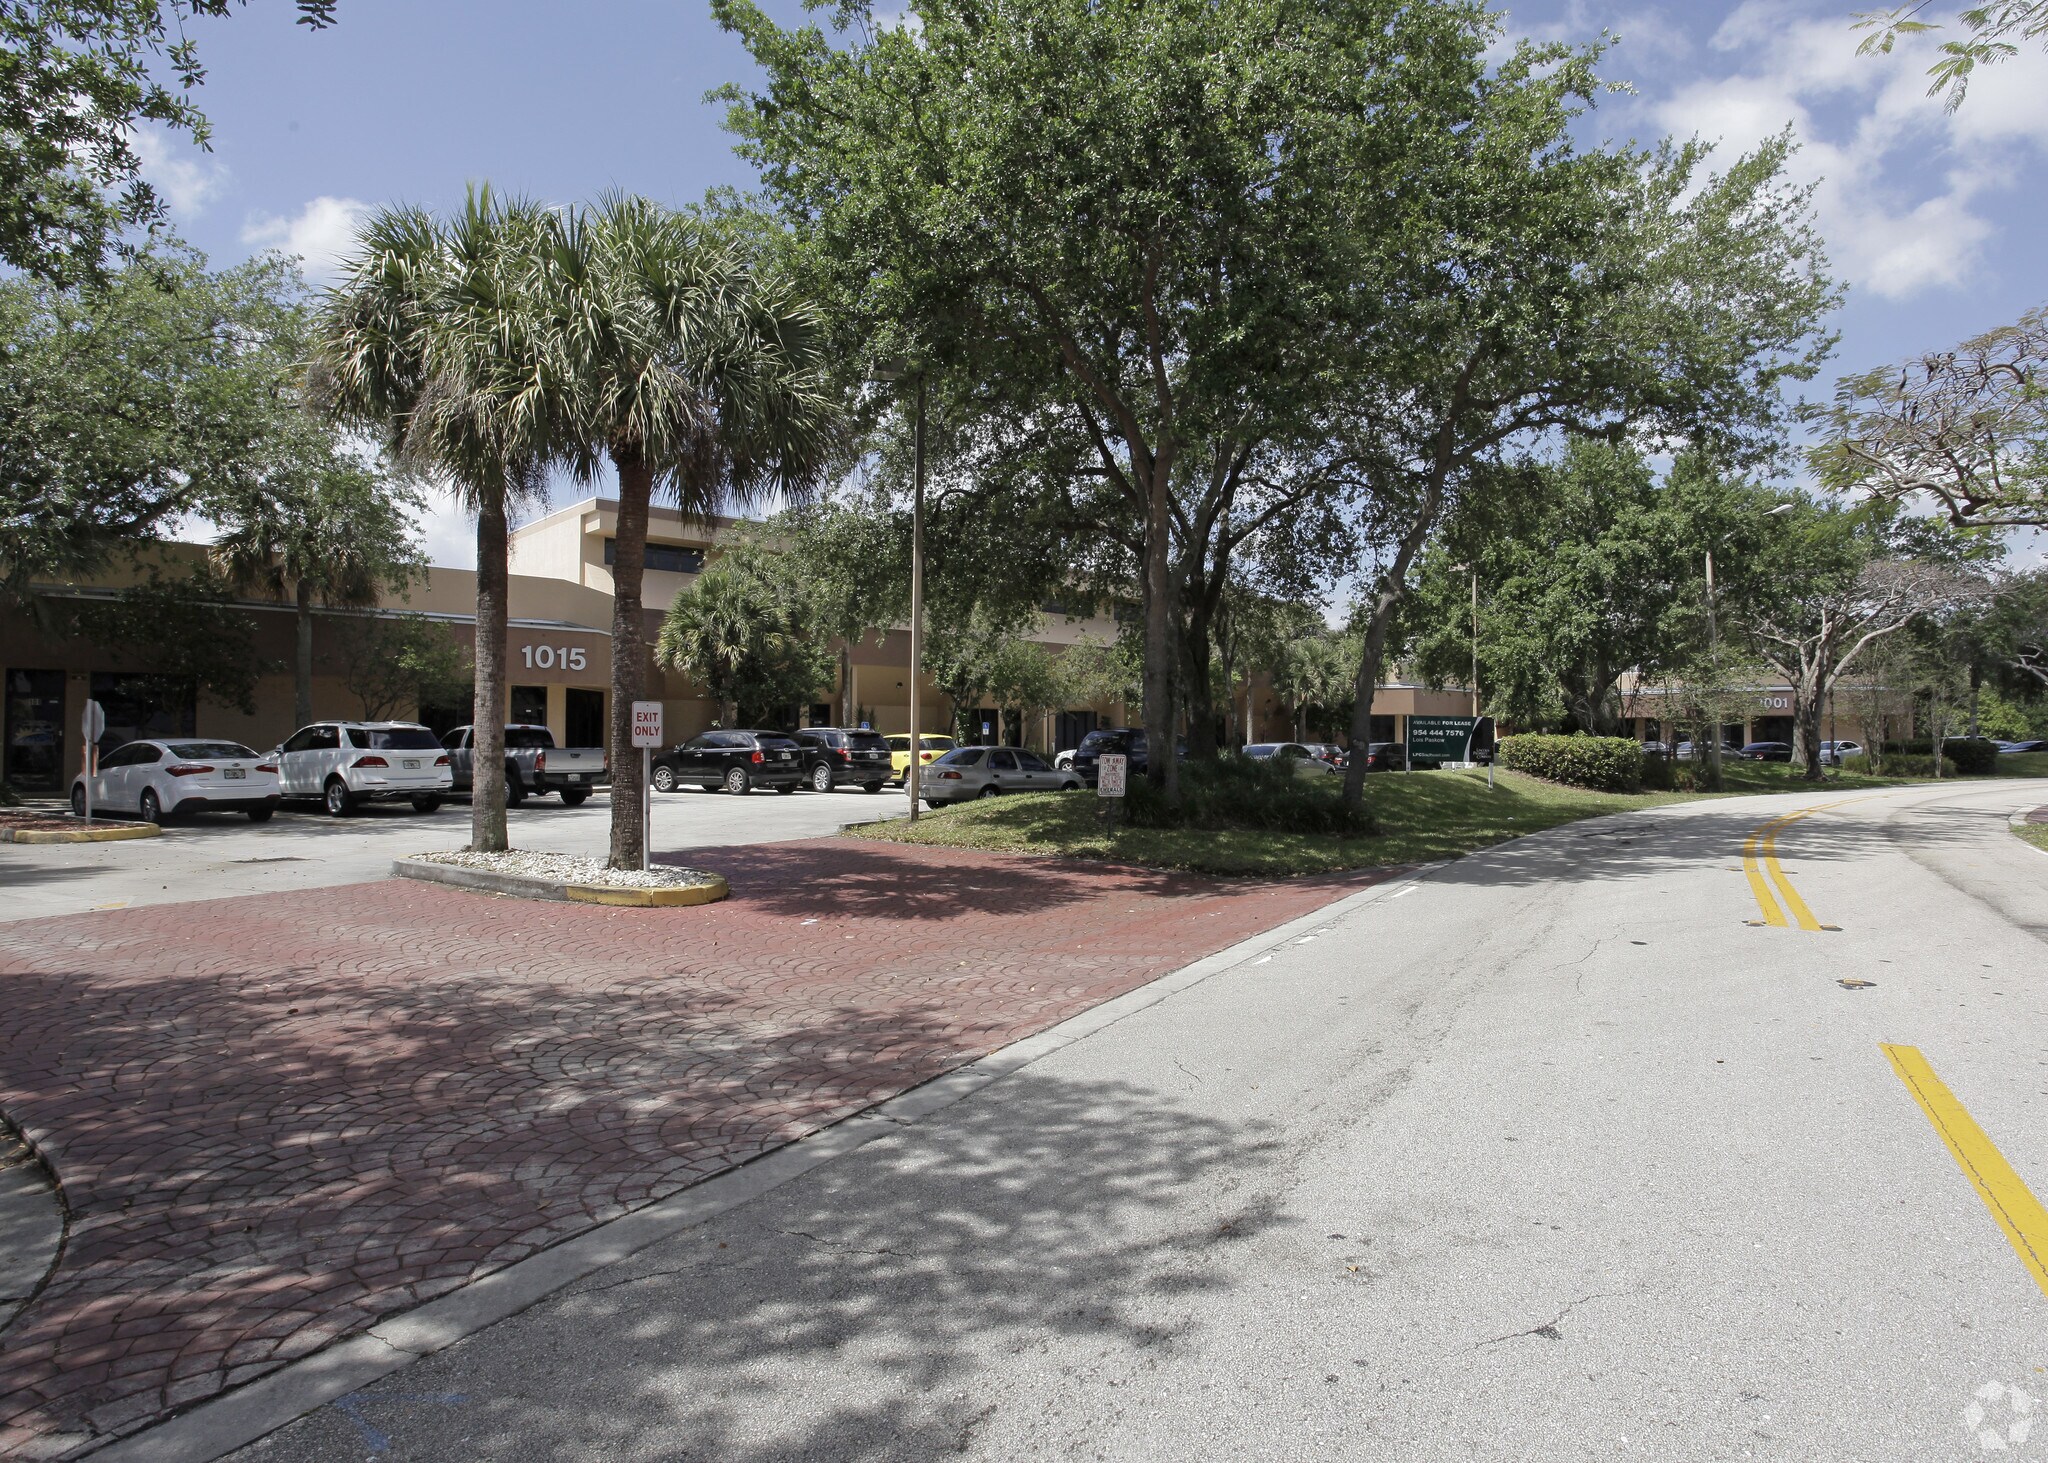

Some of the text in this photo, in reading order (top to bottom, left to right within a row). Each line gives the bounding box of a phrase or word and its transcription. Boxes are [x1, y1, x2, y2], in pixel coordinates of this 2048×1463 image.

[521, 645, 587, 671] 1015
[636, 712, 658, 722] EXIT
[634, 726, 660, 737] ONLY
